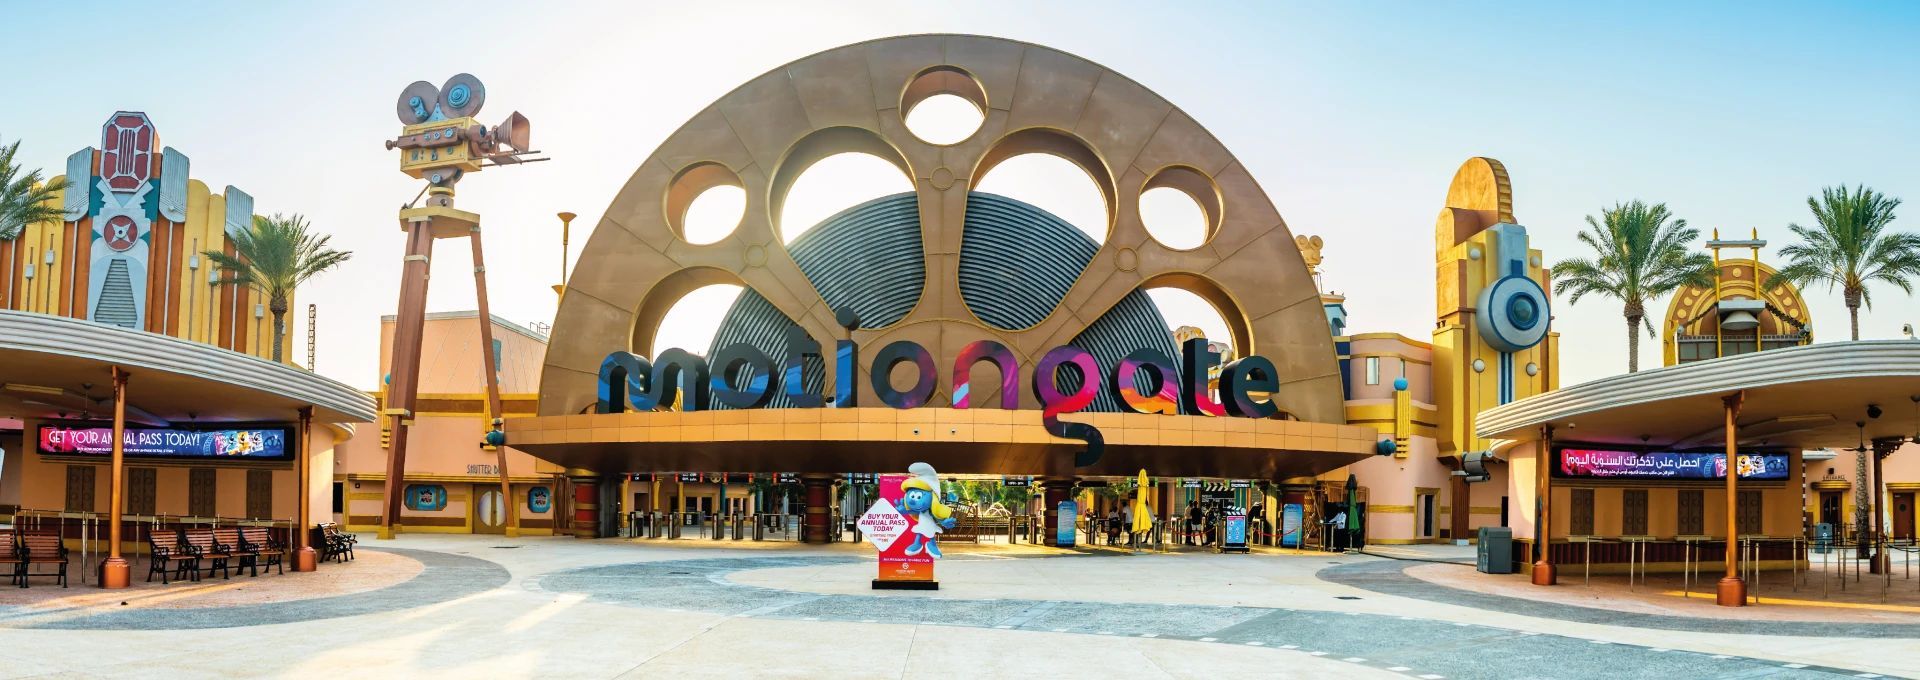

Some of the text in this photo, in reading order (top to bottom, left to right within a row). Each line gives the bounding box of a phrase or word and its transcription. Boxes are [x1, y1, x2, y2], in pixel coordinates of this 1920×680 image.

[599, 307, 1280, 468] motiongate
[48, 430, 66, 443] GET
[101, 431, 136, 445] ANAL
[139, 432, 162, 445] PASS
[165, 432, 200, 446] TODAY!
[1590, 453, 1623, 467] السنوية
[1623, 455, 1655, 469] تذكرتك
[1655, 456, 1673, 469] على
[1674, 456, 1700, 468] احصل
[466, 464, 491, 474] SHUTTER
